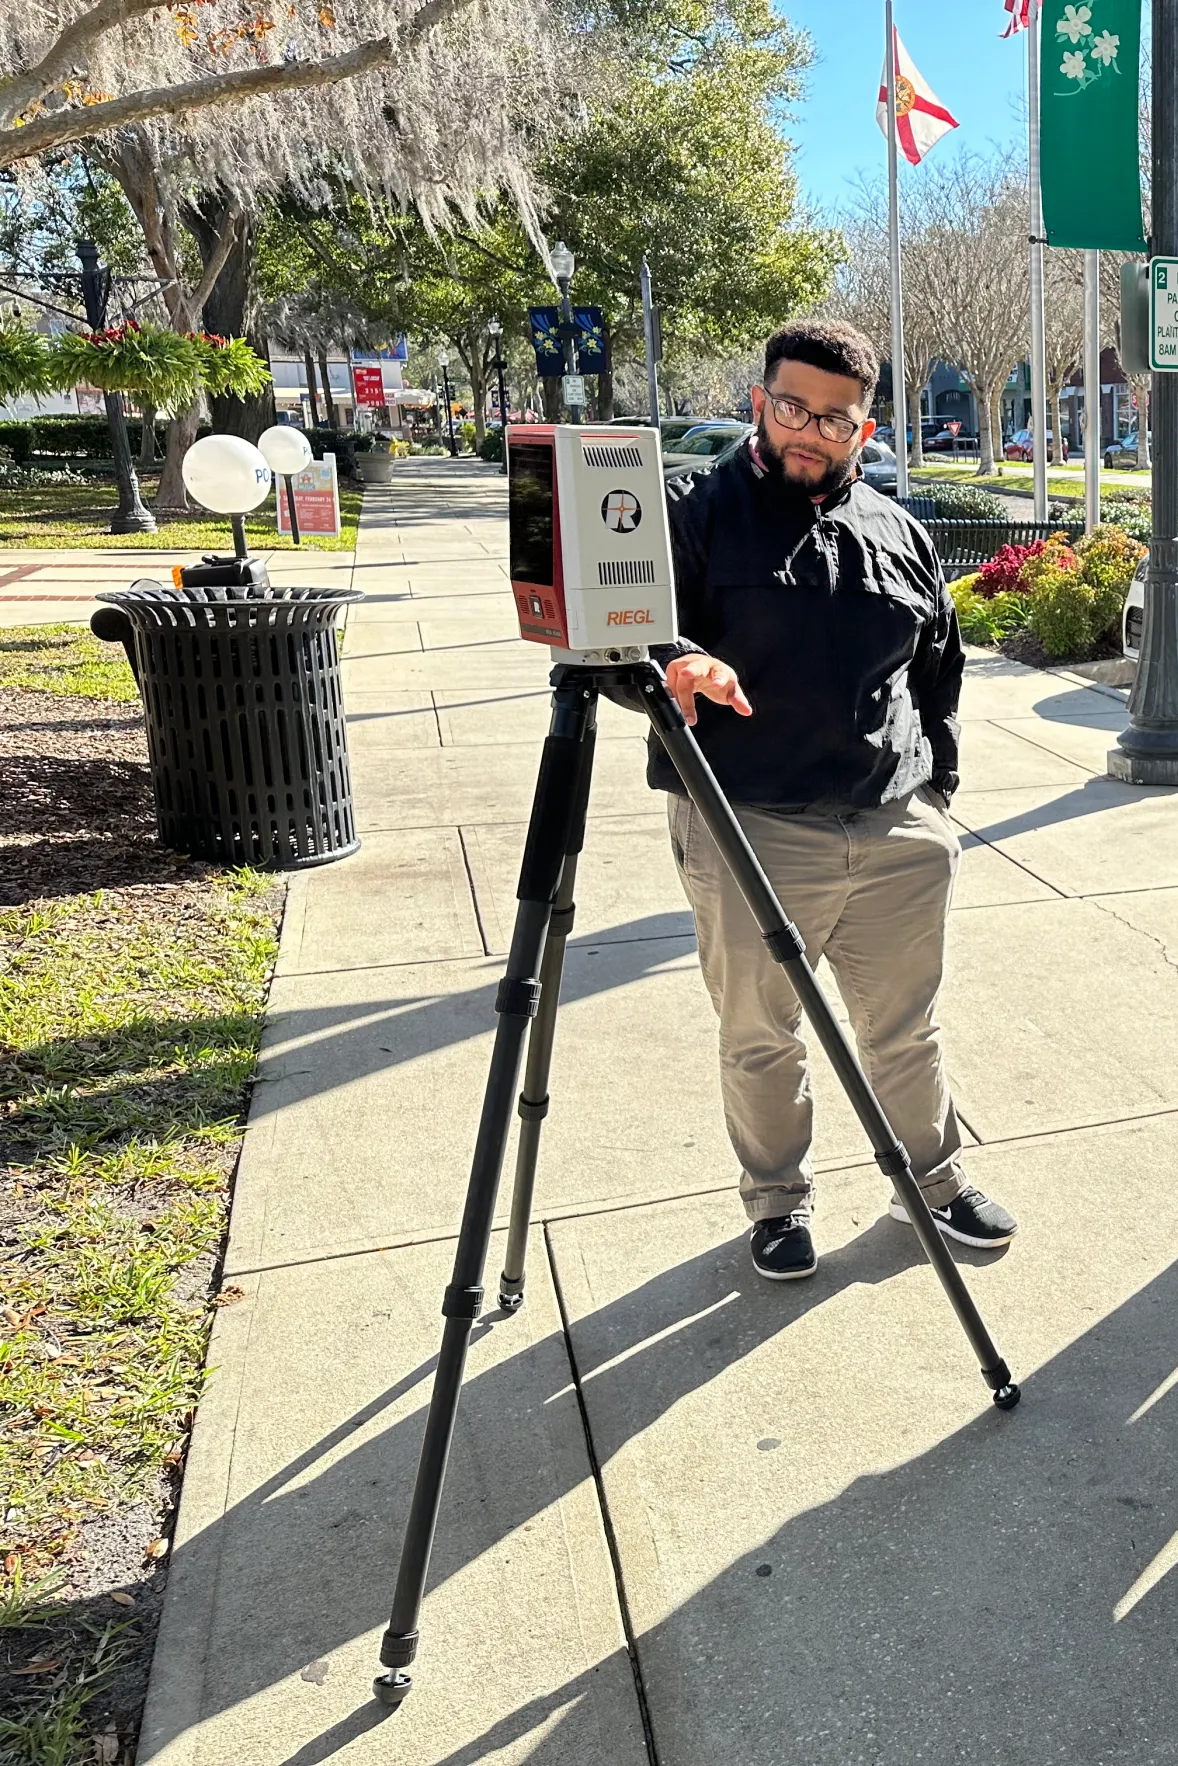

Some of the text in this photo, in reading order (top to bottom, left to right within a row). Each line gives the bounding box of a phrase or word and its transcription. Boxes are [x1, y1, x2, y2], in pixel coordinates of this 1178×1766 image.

[1157, 271, 1166, 284] 2
[1157, 326, 1178, 339] PLANT
[1158, 343, 1177, 356] 8AM
[607, 609, 655, 626] RIEGL
